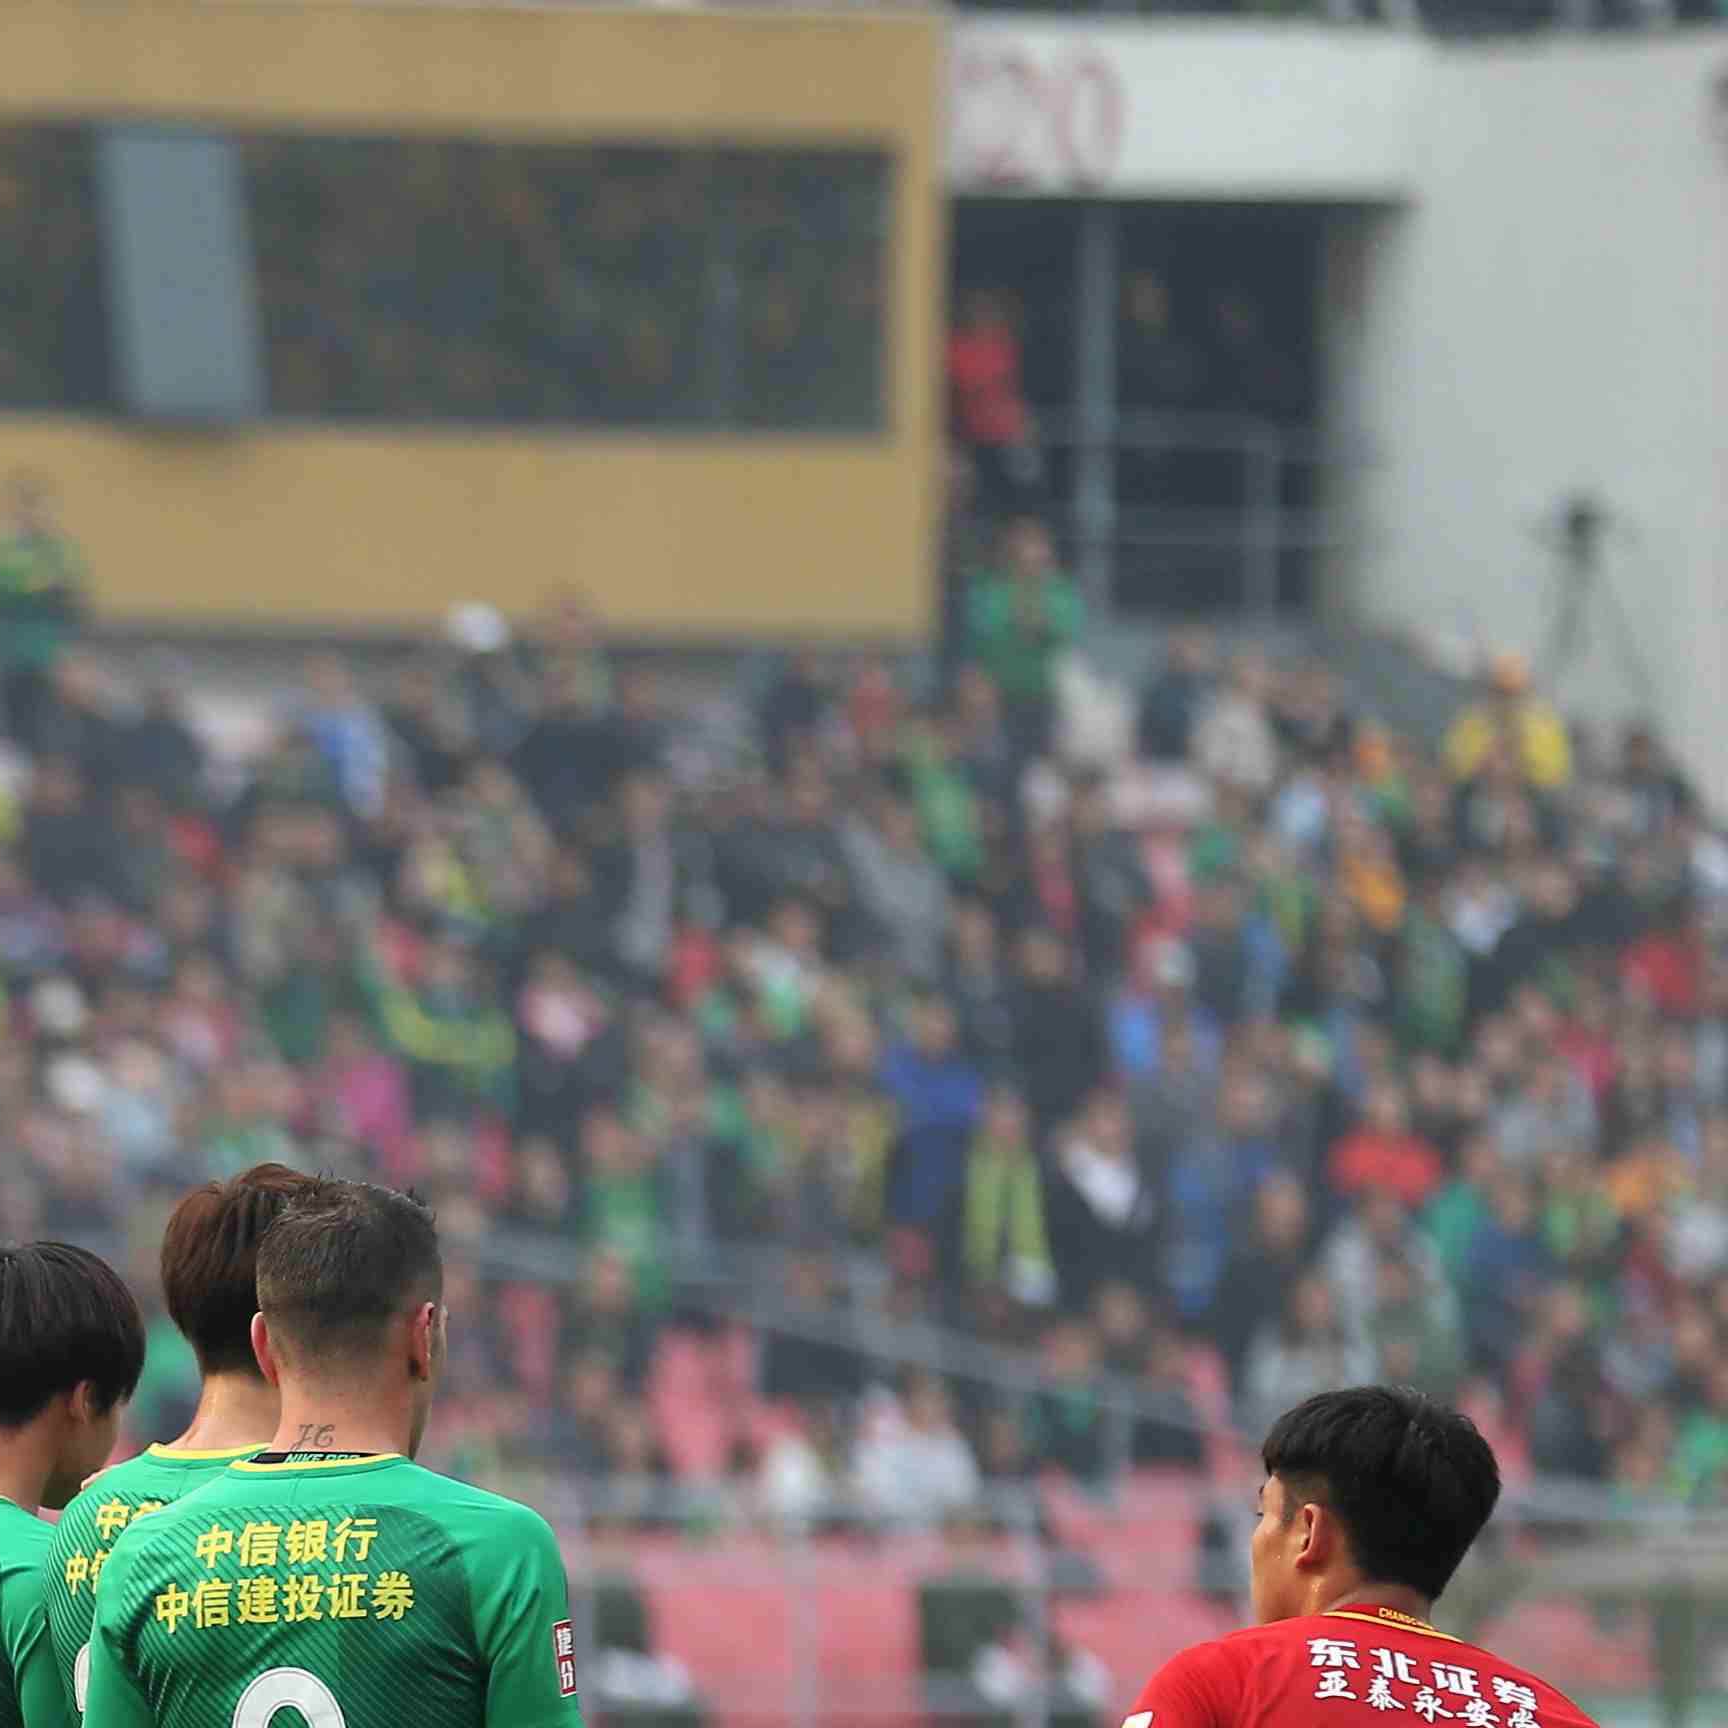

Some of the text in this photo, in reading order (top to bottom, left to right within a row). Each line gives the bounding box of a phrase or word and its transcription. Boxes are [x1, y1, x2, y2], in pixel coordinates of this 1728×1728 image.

[195, 1516, 379, 1569] 中信银行
[154, 1571, 415, 1634] 中信建投证券
[1306, 1637, 1539, 1711] 东北证券
